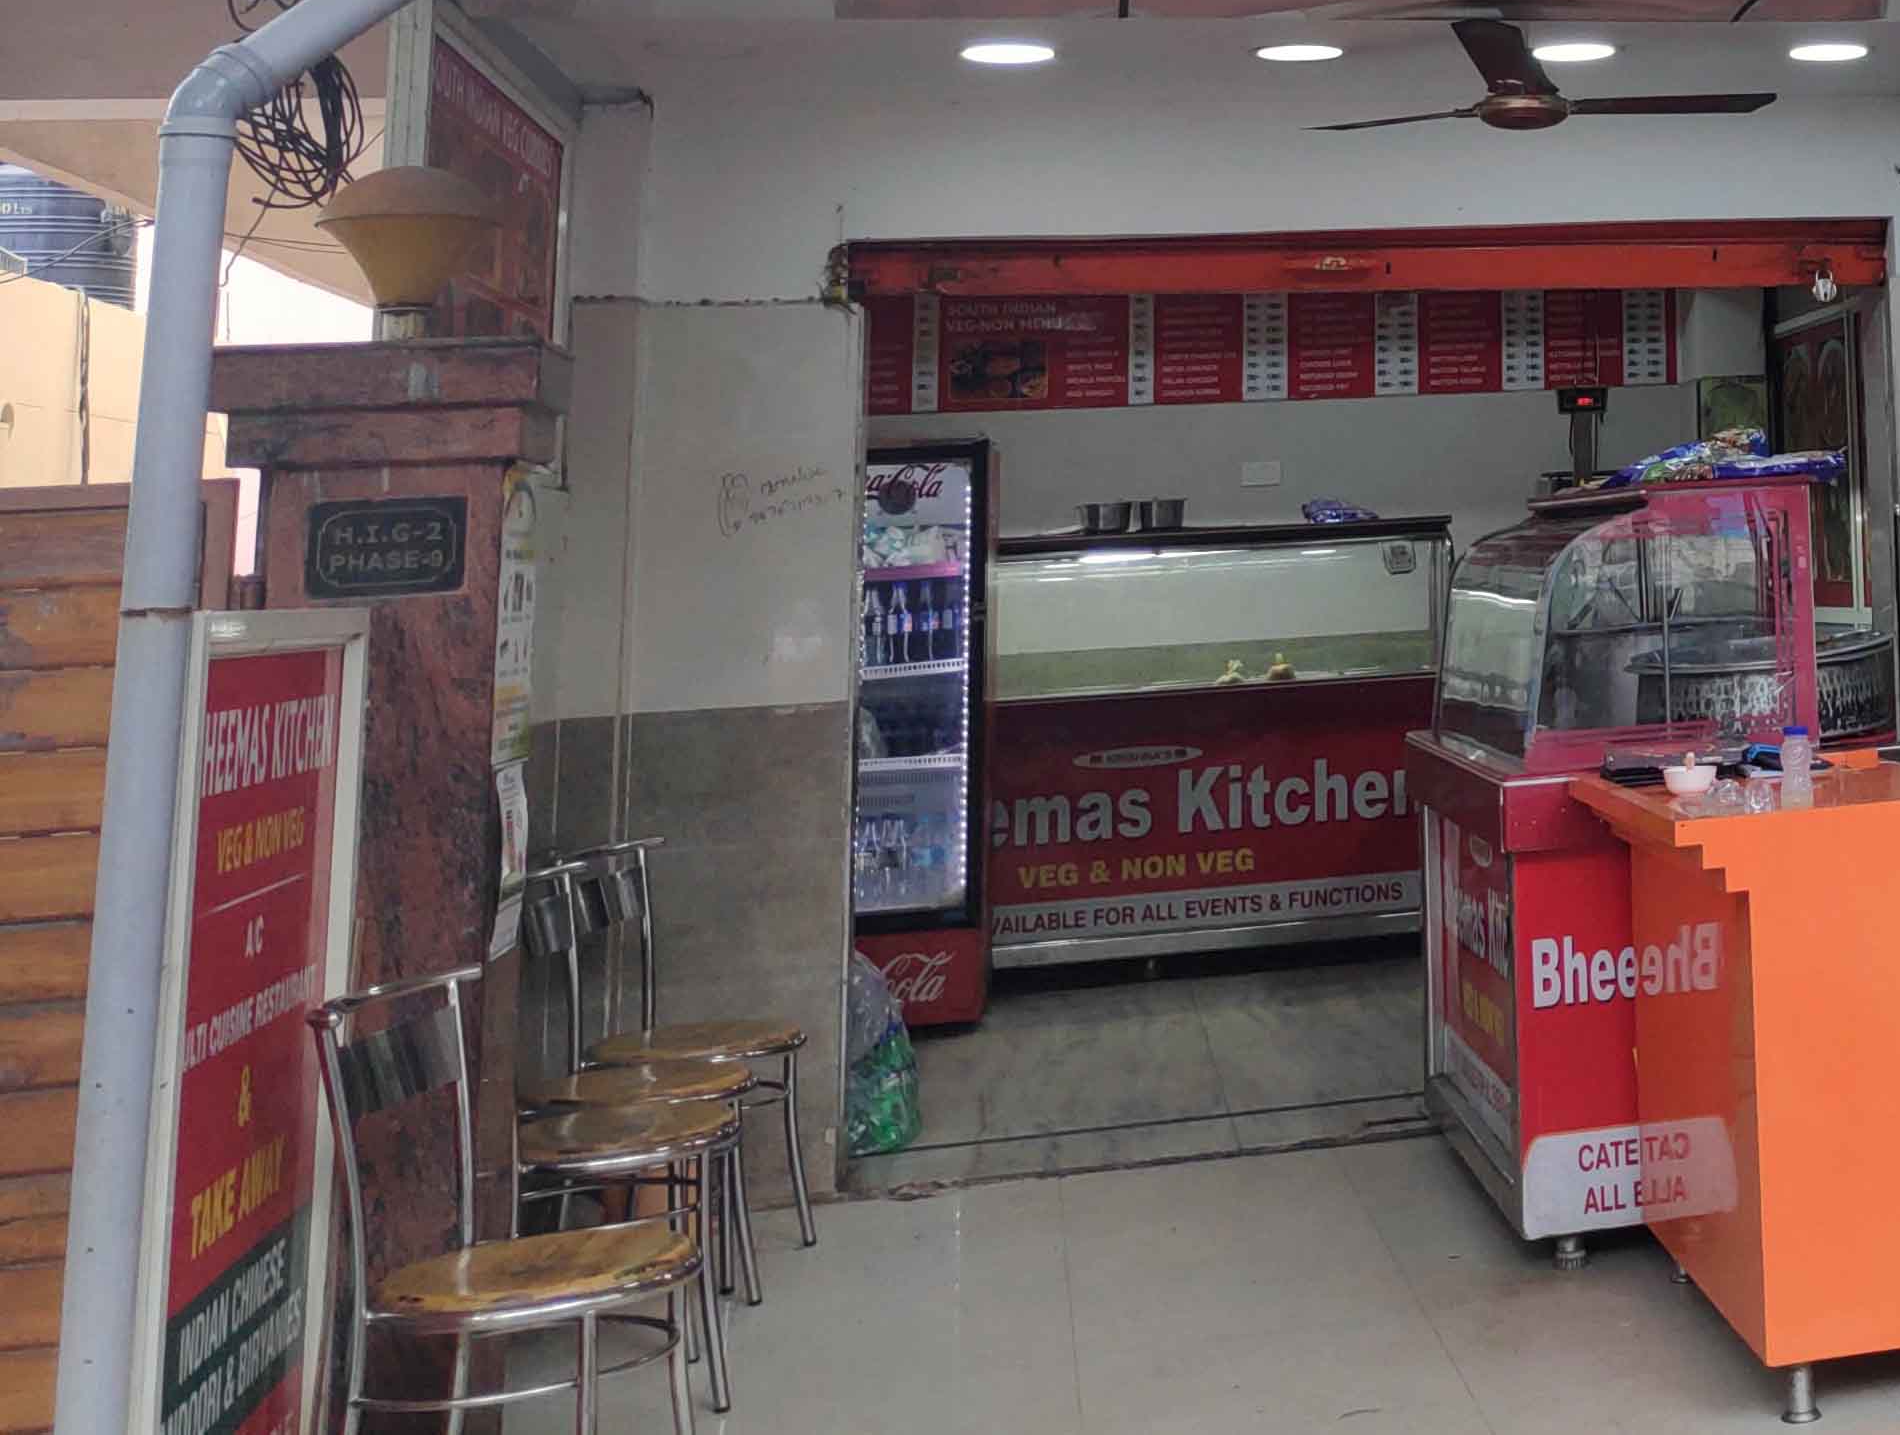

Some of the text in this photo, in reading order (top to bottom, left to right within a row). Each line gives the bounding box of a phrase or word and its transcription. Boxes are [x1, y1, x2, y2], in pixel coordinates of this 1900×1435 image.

[270, 693, 338, 782] KITCHEN
[215, 822, 244, 876] VEG
[255, 812, 284, 860] NON
[284, 805, 306, 851] VEG
[1017, 847, 1256, 889] VEG & NON VEG
[1092, 905, 1135, 929] FOR
[1142, 903, 1177, 923] ALL
[1184, 893, 1264, 920] EVENTS
[1268, 892, 1282, 912] &
[1288, 881, 1405, 911] FUNCTIONS
[208, 999, 254, 1055] CUISINE
[255, 964, 315, 1030] RESTAURANT
[236, 1066, 252, 1128] &
[189, 1134, 286, 1262] TAKE AWAY
[1583, 1183, 1627, 1215] ALL
[177, 1236, 286, 1388] INDIAN CHINESE
[161, 1365, 223, 1435] NDOORI
[223, 1354, 235, 1411] &
